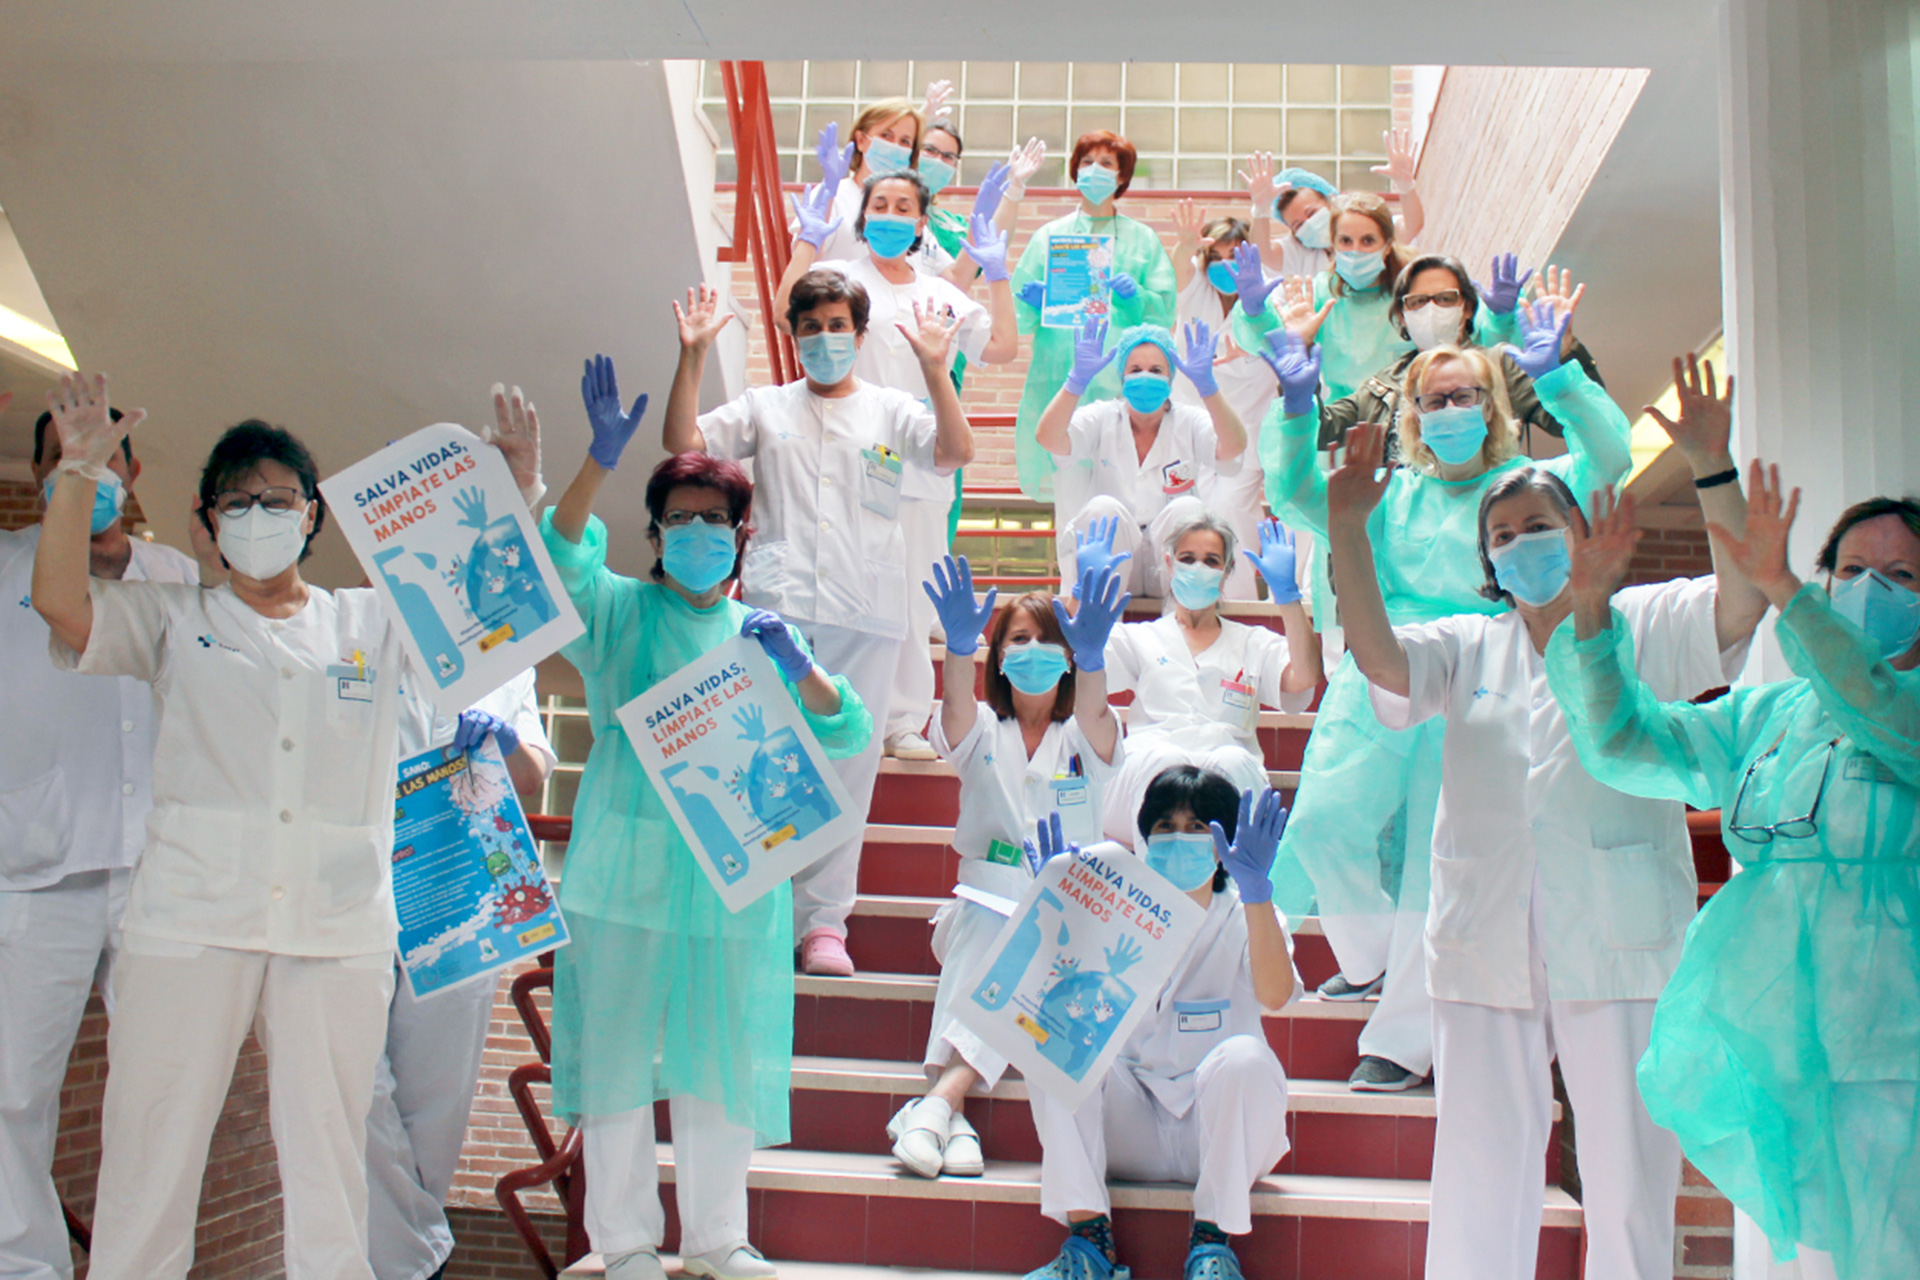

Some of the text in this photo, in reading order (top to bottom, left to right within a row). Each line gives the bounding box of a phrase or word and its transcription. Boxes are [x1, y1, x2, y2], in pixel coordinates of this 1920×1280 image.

[354, 442, 468, 508] SALVA VIDAS,
[363, 455, 477, 526] LÍMPIATE LAS
[373, 499, 437, 543] MANOS
[645, 662, 746, 729] SALVA VIDAS,
[652, 675, 753, 744] LÍMPIATE LAS
[660, 717, 718, 759] MANOS
[402, 777, 425, 795] LAS
[1057, 877, 1113, 924] MANOS
[1067, 861, 1165, 941] LÍMPIATE LAS
[1078, 851, 1173, 929] SALVA VIDAS,
